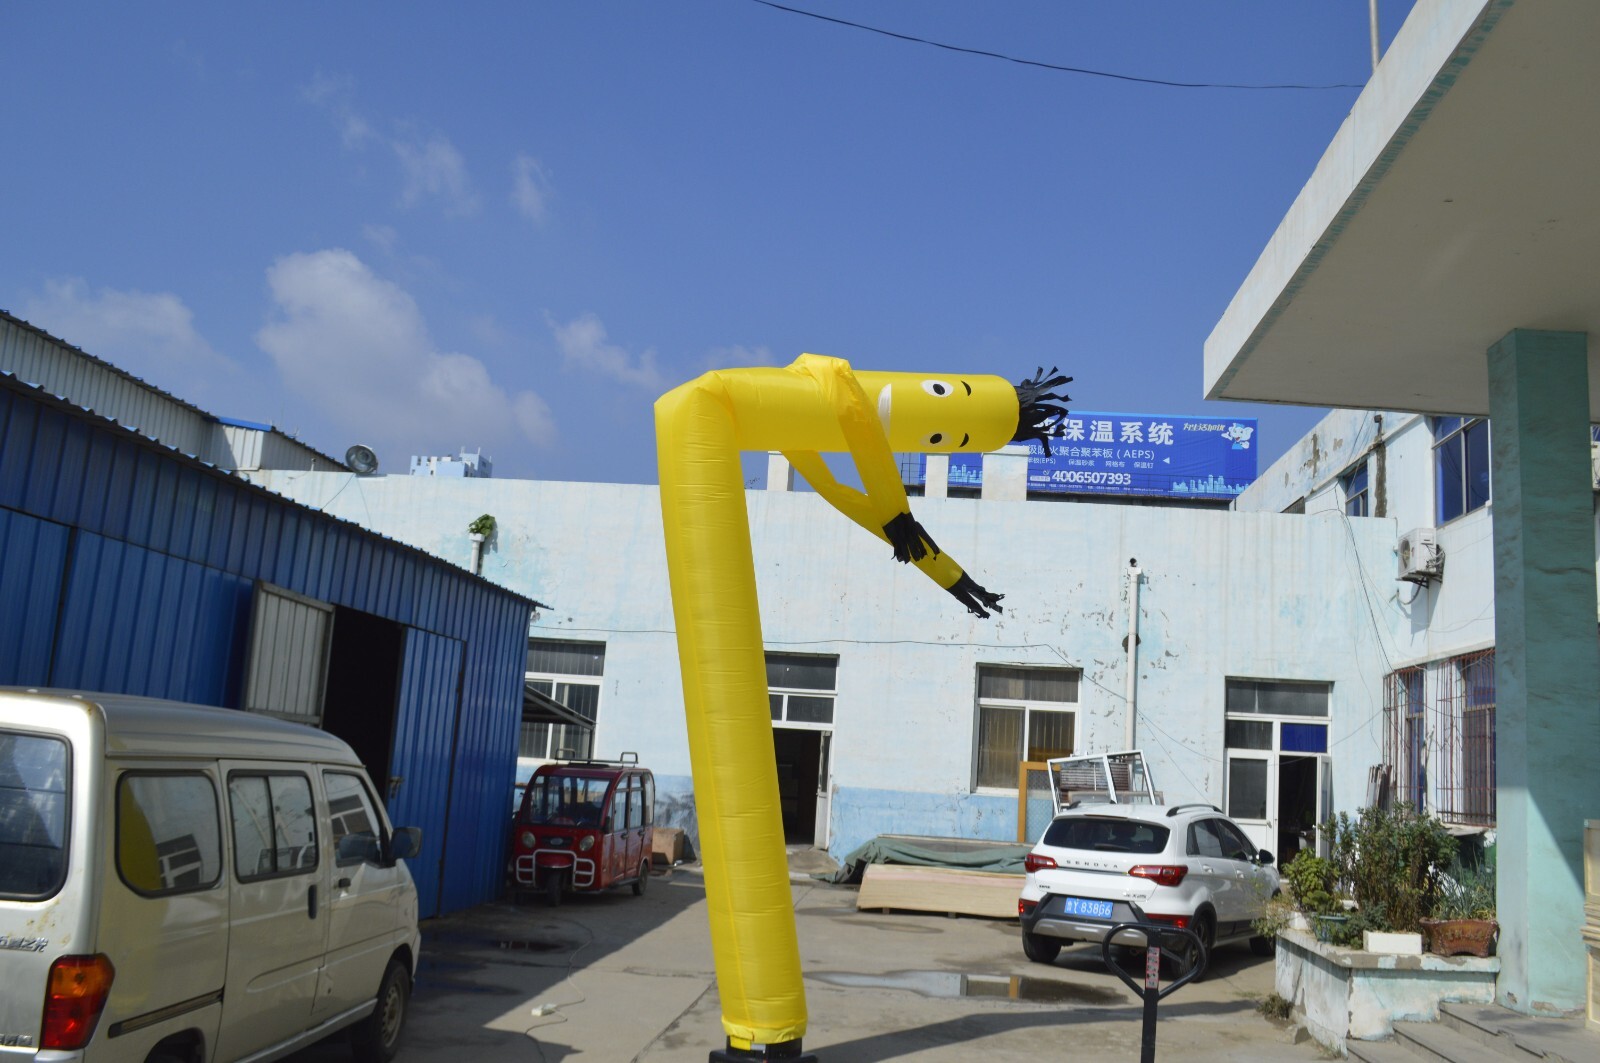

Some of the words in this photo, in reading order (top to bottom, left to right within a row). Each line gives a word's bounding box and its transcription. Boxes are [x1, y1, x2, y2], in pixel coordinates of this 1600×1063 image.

[1033, 418, 1174, 445] 保温系统
[1052, 470, 1131, 485] 4006507393
[1066, 860, 1118, 868] SENOVA
